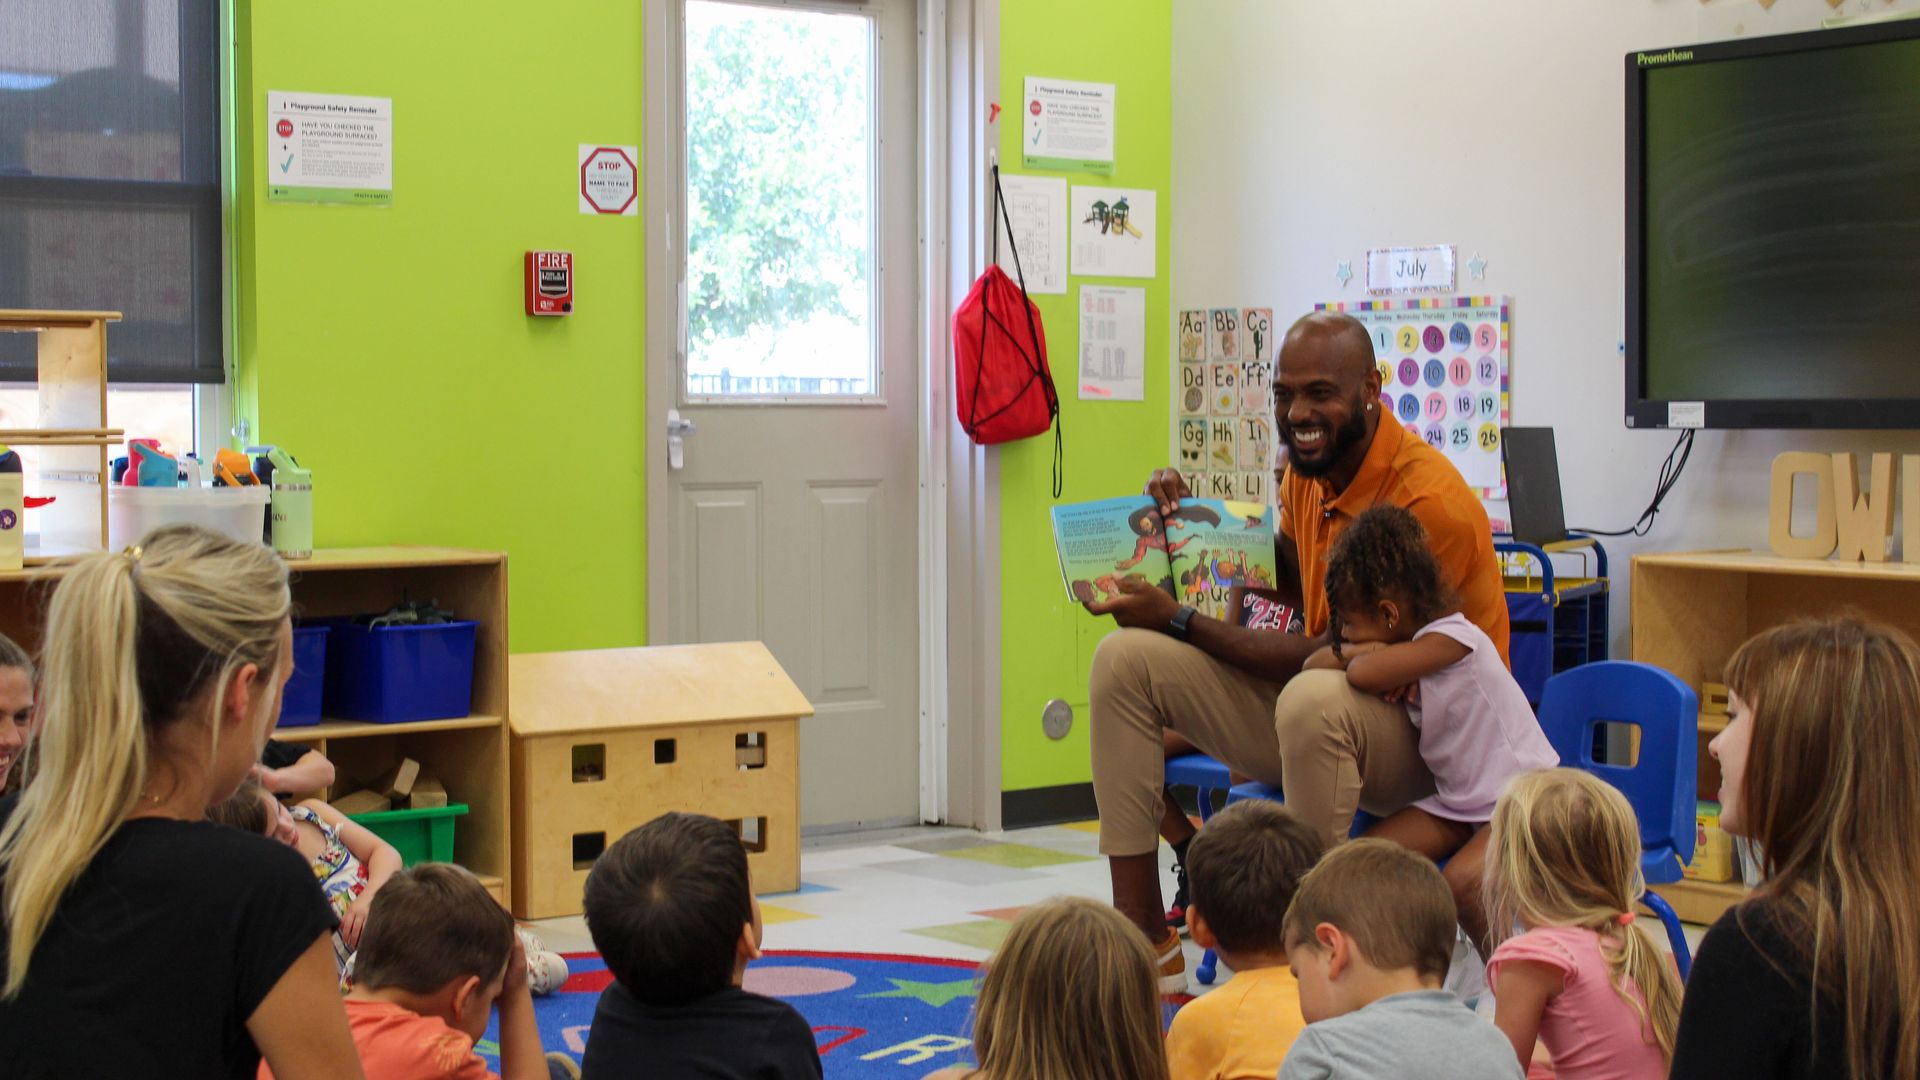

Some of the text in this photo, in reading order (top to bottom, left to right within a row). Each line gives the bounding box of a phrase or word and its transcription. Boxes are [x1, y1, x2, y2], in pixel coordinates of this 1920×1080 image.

[1637, 49, 1693, 65] Promethean
[291, 101, 377, 114] Playground Safety Reminder
[301, 121, 374, 132] HAVE YOU CHECKED THE
[302, 130, 378, 140] PLAYGROUND SURFACES?
[598, 162, 621, 170] STOP
[538, 253, 568, 268] FIRE
[1396, 257, 1427, 280] July
[1182, 310, 1267, 333] Aa Bb Cc
[1423, 311, 1446, 320] Thursday
[1452, 311, 1468, 319] Friday
[1476, 310, 1498, 318] Saturday
[1380, 333, 1385, 348] 1
[1403, 333, 1411, 348] 2
[1430, 332, 1438, 346] 3
[1481, 331, 1489, 346] 5
[1183, 365, 1265, 388] Dd Ee Ff
[1405, 364, 1412, 378] 9
[1427, 364, 1440, 381] 10
[1455, 365, 1464, 380] 11
[1480, 363, 1491, 379] 12
[1402, 399, 1414, 416] 16
[1429, 400, 1441, 414] 17
[1458, 397, 1470, 412] 18
[1481, 398, 1493, 414] 19
[1183, 421, 1204, 447] Gg
[1213, 421, 1232, 442] Hh
[1427, 428, 1497, 447] 24 25 26
[1213, 475, 1232, 495] Kk
